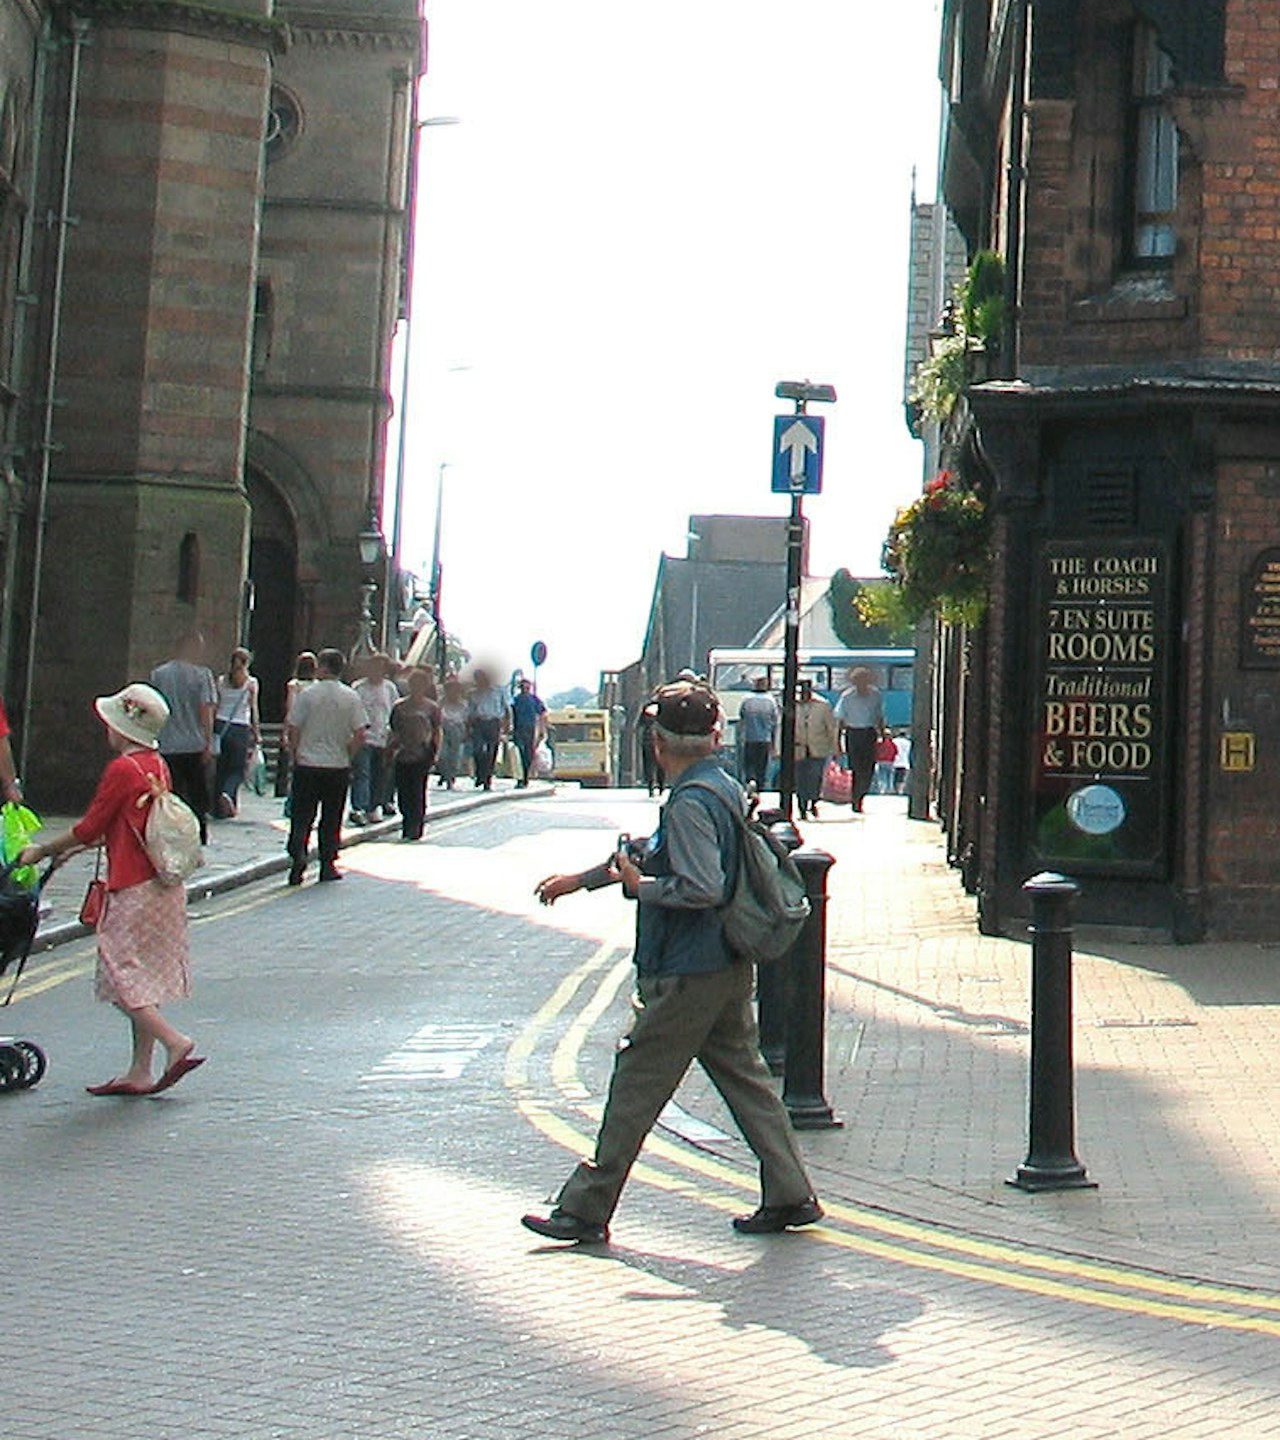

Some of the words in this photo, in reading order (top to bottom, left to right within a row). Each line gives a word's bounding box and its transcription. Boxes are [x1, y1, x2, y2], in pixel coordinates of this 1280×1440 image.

[1050, 557, 1086, 575] THE
[1093, 556, 1159, 575] COACH
[1057, 578, 1069, 594] &
[1073, 577, 1149, 595] HORSES
[1047, 609, 1060, 629] 7
[1063, 608, 1090, 630] EN
[1094, 608, 1154, 630] SUITE
[1048, 632, 1155, 662] ROOMS
[1046, 673, 1152, 698] Traditional
[1045, 701, 1153, 738] BEERS
[1043, 740, 1064, 768] &
[1071, 741, 1151, 769] FOOD
[1225, 736, 1250, 768] H
